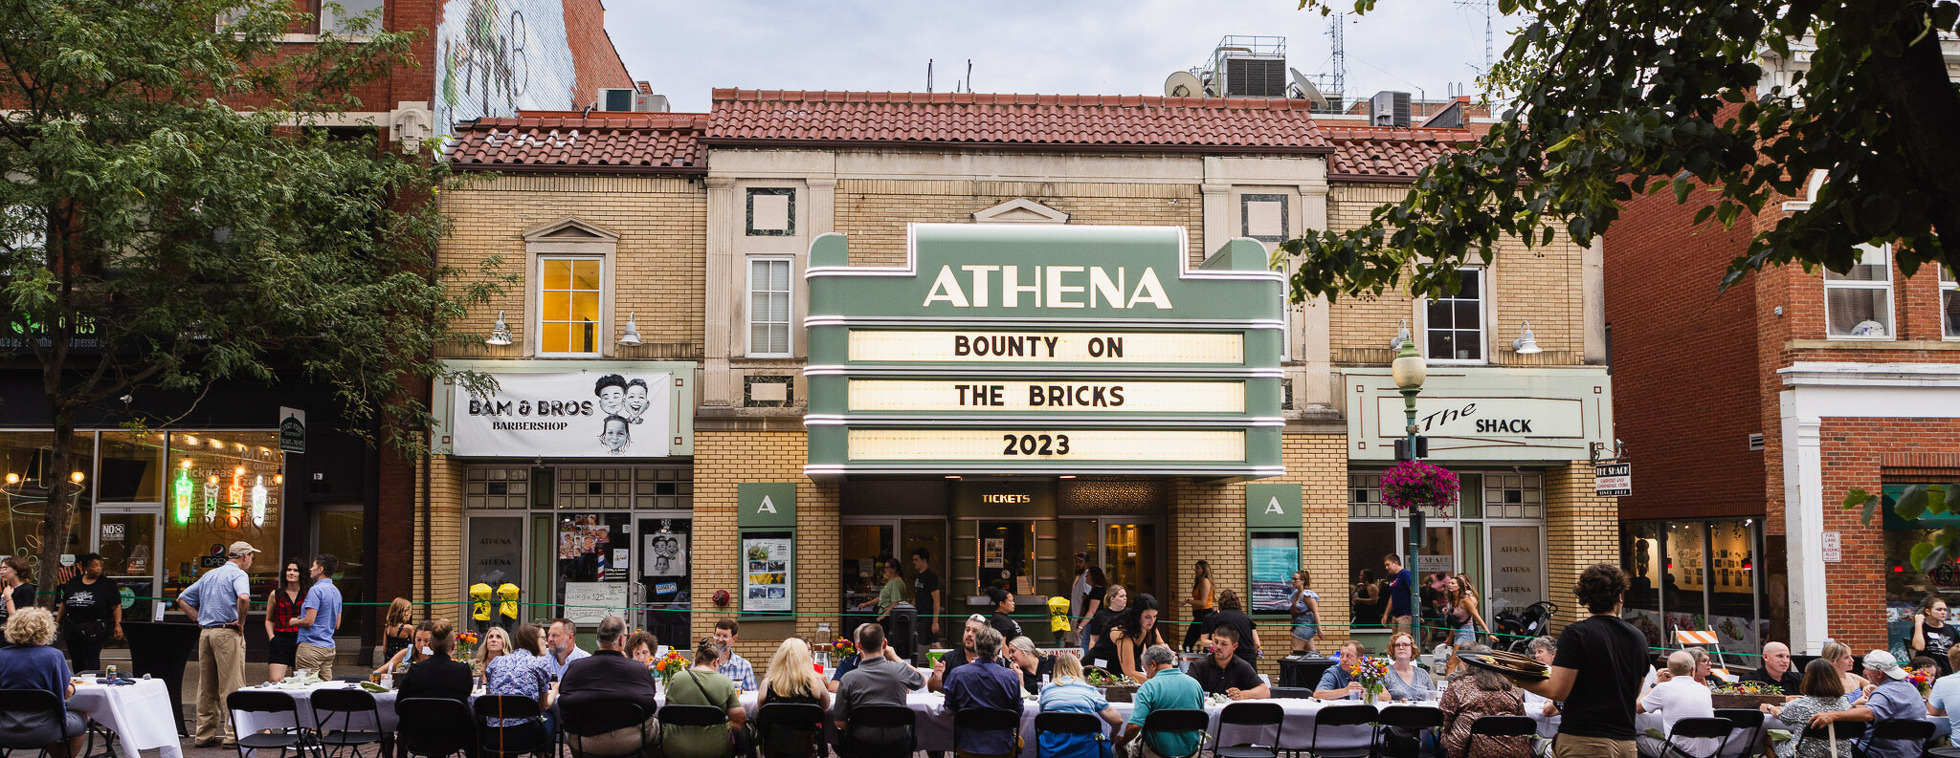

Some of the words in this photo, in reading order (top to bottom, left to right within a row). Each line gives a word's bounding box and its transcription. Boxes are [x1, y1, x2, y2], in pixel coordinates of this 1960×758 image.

[922, 264, 1173, 310] ATHENA
[954, 335, 1059, 358] BOUNTY
[1088, 337, 1123, 358] ON
[954, 385, 1005, 406] THE
[1029, 385, 1125, 407] BRICKS
[469, 400, 512, 416] BAM
[519, 400, 532, 416] &
[538, 400, 594, 416] BROS
[1421, 403, 1476, 432] The
[492, 421, 568, 431] BARBERSHOP
[1476, 419, 1532, 433] SHACK
[1003, 434, 1070, 455] 2023
[1597, 467, 1607, 476] THE
[1608, 466, 1628, 475] SHACK
[756, 495, 778, 514] A
[981, 494, 1030, 504] TICKETS
[1264, 495, 1285, 515] A
[102, 525, 115, 534] NO
